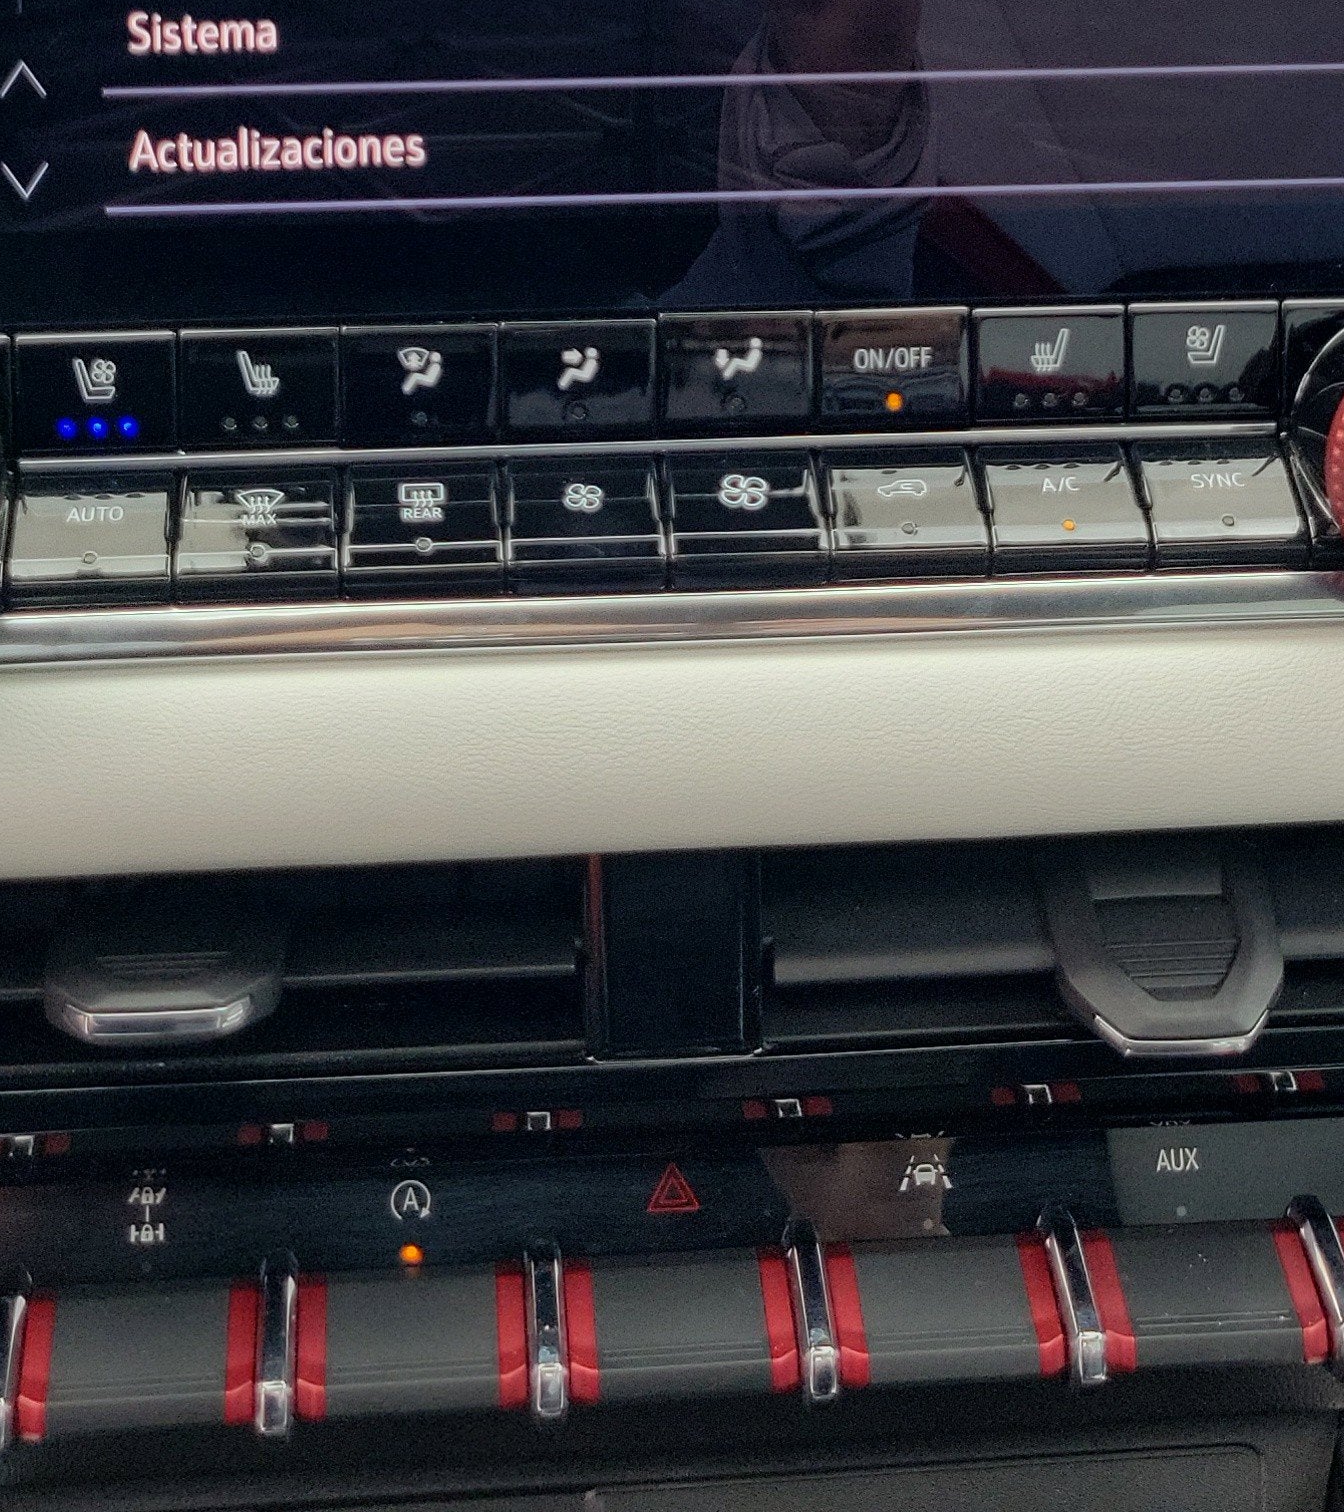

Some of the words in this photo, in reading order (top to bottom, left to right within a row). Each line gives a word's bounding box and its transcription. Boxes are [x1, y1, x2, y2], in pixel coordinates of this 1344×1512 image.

[127, 12, 278, 54] Sistema
[128, 128, 427, 174] Actualizaciones
[855, 346, 933, 370] ON/OFF
[1042, 476, 1081, 493] A/C
[1190, 472, 1245, 489] SYNC
[66, 505, 125, 523] AUTO
[240, 512, 278, 527] MAX
[402, 506, 444, 521] REAR
[1155, 1146, 1201, 1173] AUX
